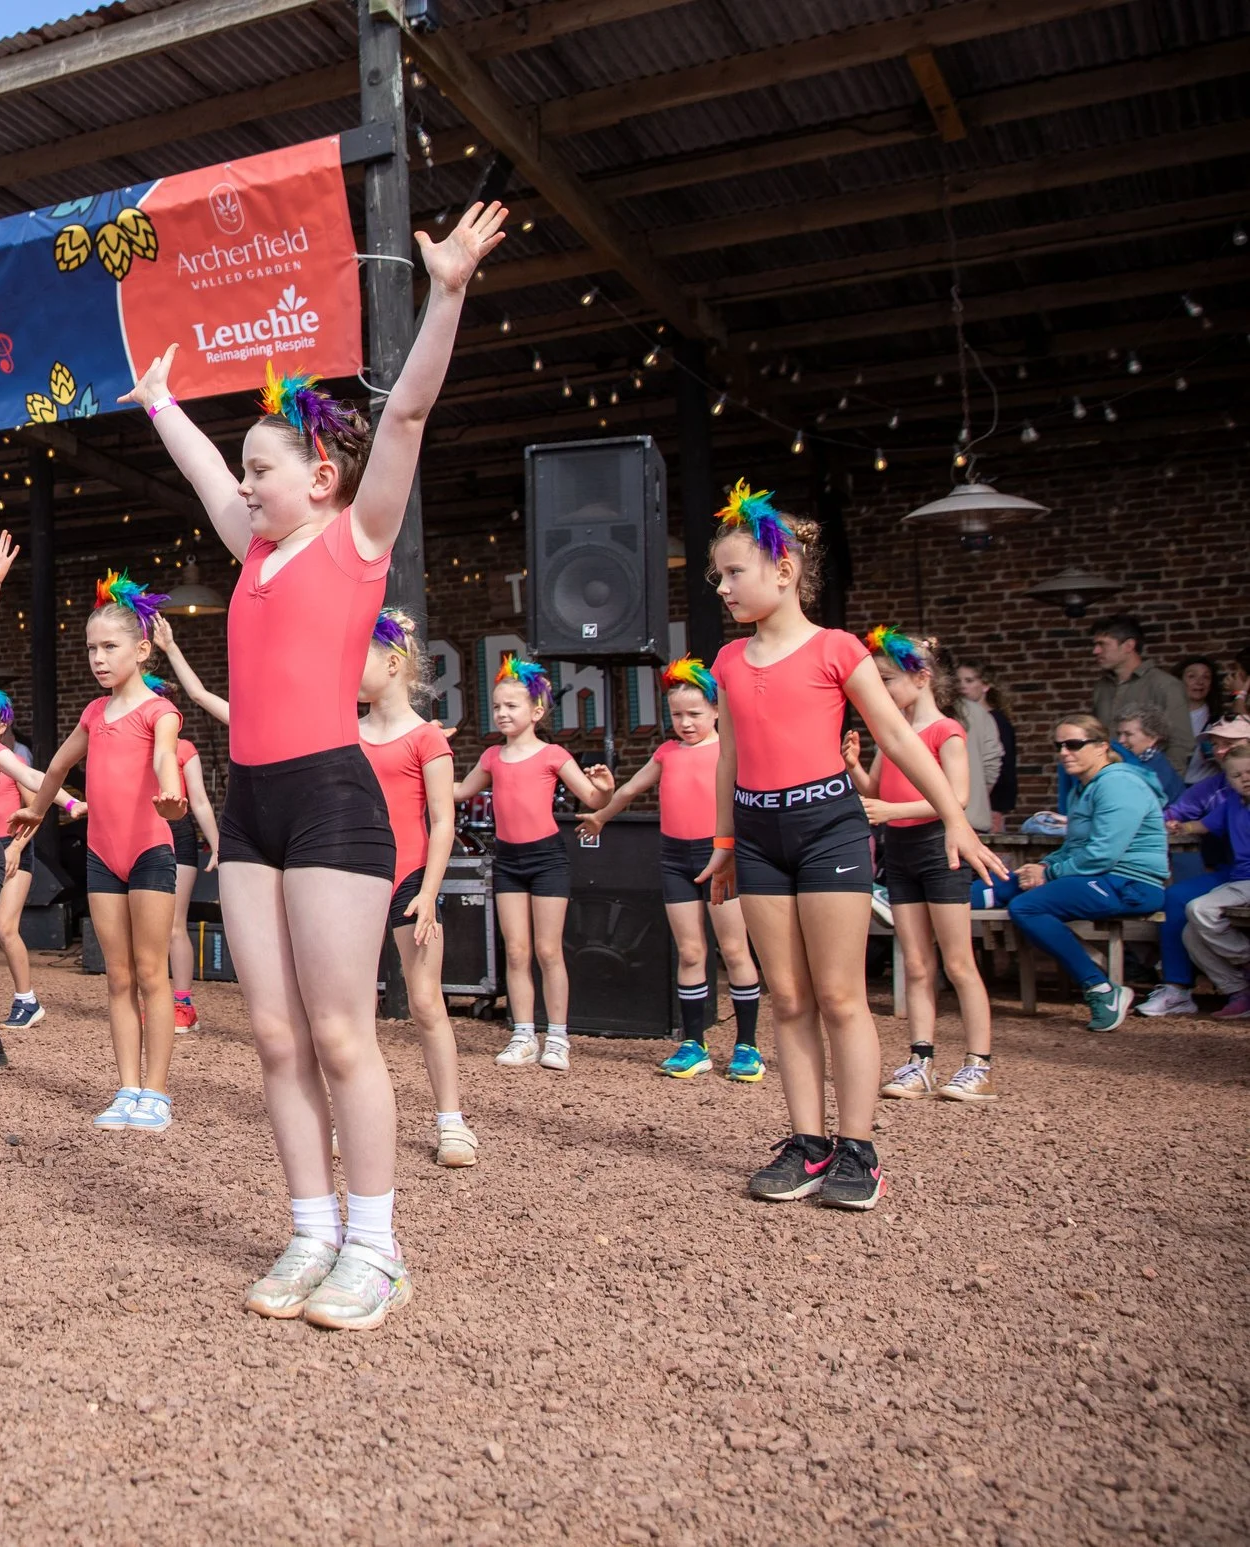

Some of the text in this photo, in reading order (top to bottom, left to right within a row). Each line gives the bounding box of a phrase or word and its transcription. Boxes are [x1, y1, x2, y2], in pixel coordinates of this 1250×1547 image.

[177, 226, 309, 276] Archerfield
[191, 260, 303, 290] WALLED GARDEN
[192, 309, 320, 351] Leuchie
[206, 336, 316, 363] Reimagining Respite
[734, 791, 781, 808] NIKE
[785, 779, 845, 807] PRO
